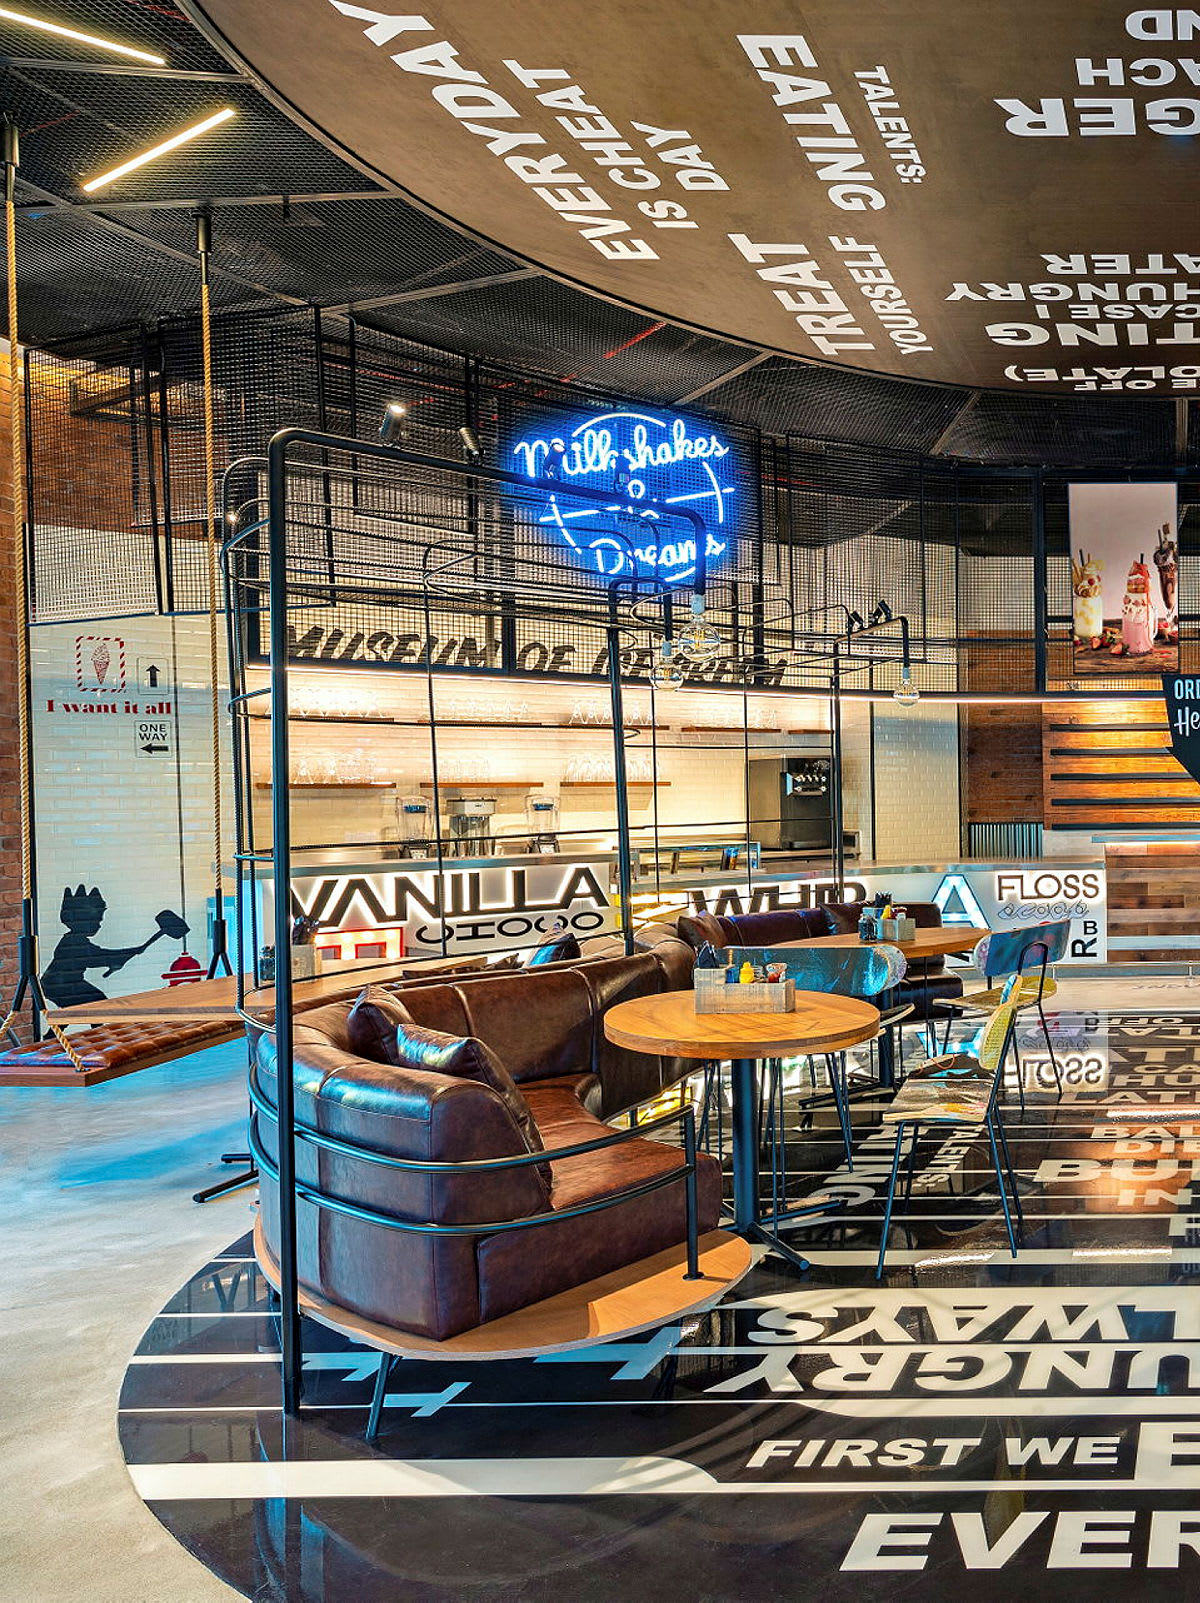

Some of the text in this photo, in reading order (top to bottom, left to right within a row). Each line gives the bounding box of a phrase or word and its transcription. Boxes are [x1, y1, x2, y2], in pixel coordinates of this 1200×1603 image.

[328, 0, 661, 260] EVERYDAY
[735, 34, 886, 211] EATING
[853, 65, 929, 185] TALENTS:
[501, 59, 700, 229] IS CHEAT
[629, 120, 731, 191] DAY
[727, 233, 876, 356] TREAT
[827, 235, 934, 355] YOURSELF
[1035, 304, 1051, 319] I
[1073, 379, 1157, 391] OFF
[516, 642, 577, 672] OF
[47, 699, 171, 714] I want it all
[138, 732, 168, 741] WAY
[139, 723, 166, 733] ONE
[290, 866, 610, 928] VANILLA
[997, 873, 1100, 901] FLOSS
[1116, 1187, 1192, 1206] IN
[745, 1437, 982, 1468] FIRST
[1005, 1436, 1121, 1465] WE
